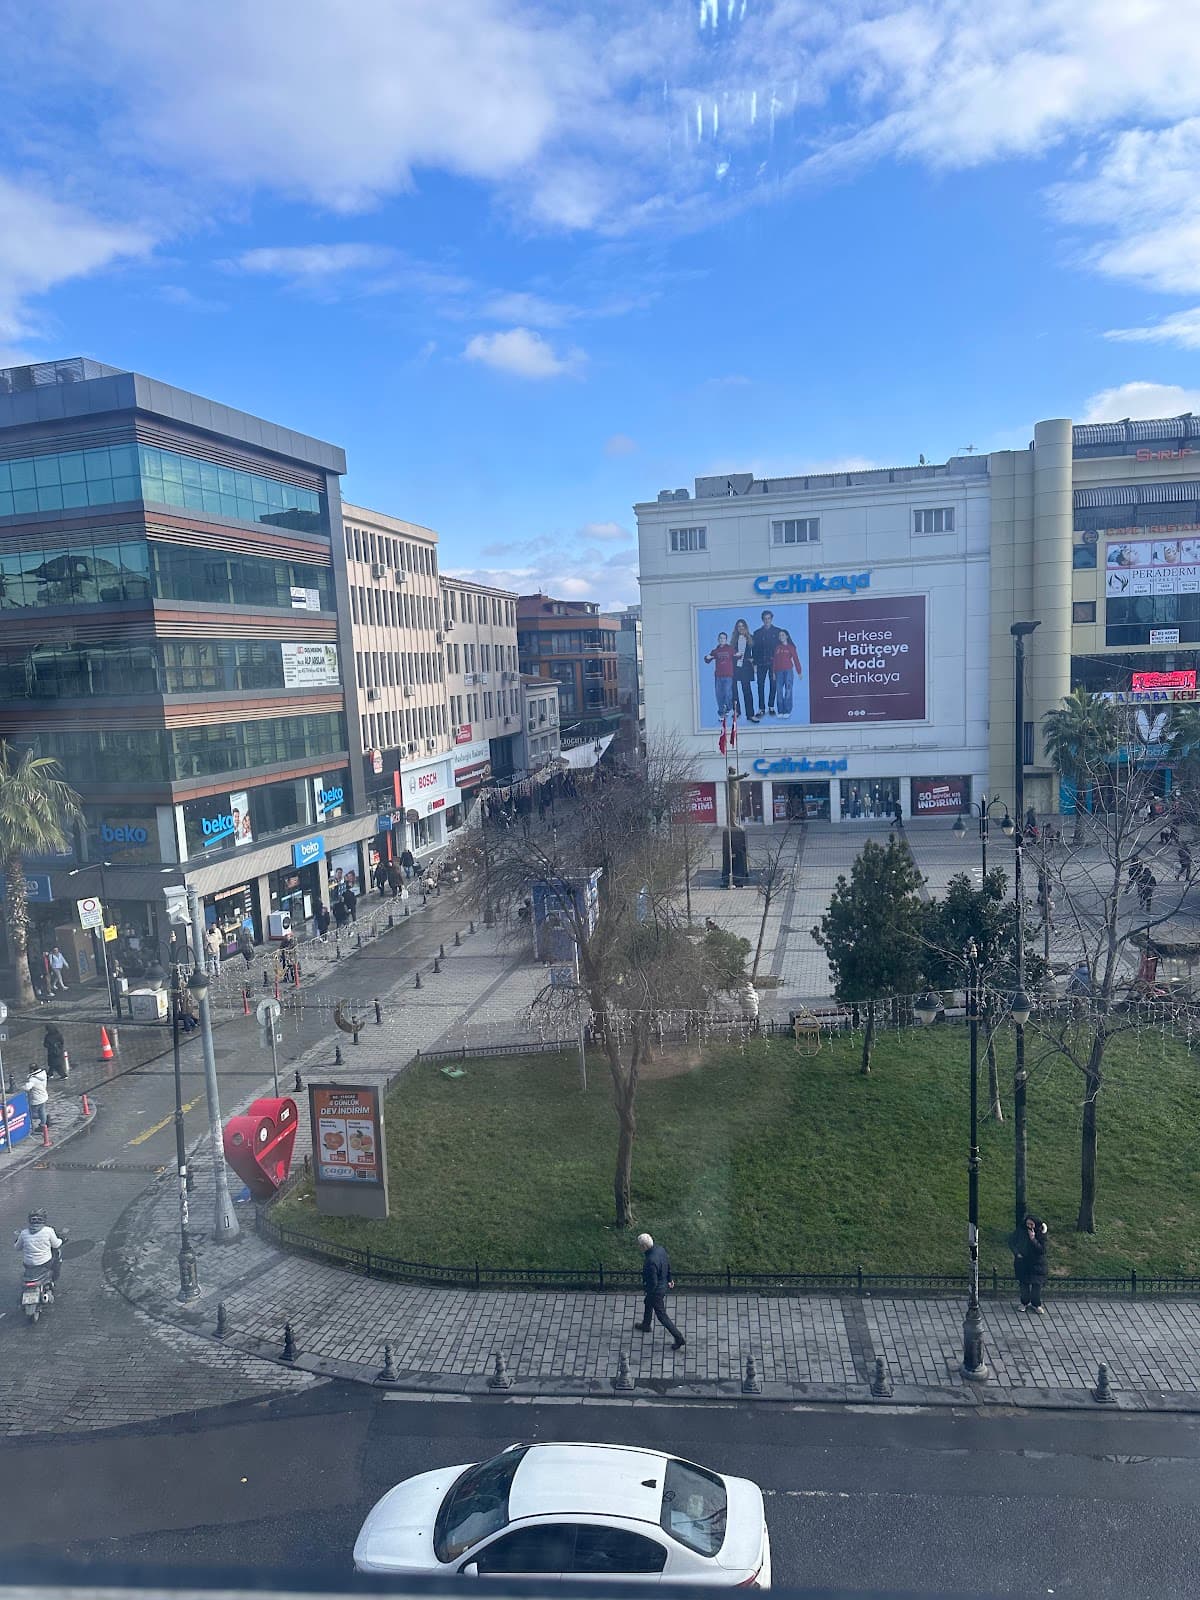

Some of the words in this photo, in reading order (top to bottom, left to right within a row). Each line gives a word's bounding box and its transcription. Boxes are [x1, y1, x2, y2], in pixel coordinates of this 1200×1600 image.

[1132, 567, 1196, 578] PERADERM
[753, 572, 871, 599] Çetinkaya
[838, 630, 892, 642] Herkese
[822, 645, 847, 657] Her
[850, 643, 909, 657] Bütçeye
[845, 657, 886, 669] Moda
[830, 671, 900, 687] Çetinkaya
[753, 756, 848, 777] Çetinkaya
[418, 772, 437, 789] BOSCH
[321, 786, 343, 803] beko
[919, 792, 932, 801] 50
[918, 798, 961, 809] İNDİRİMİ
[202, 814, 233, 835] beko
[102, 823, 146, 843] beko
[301, 842, 319, 855] beko
[320, 1107, 337, 1115] DEV
[338, 1106, 370, 1115] İNDİRİM
